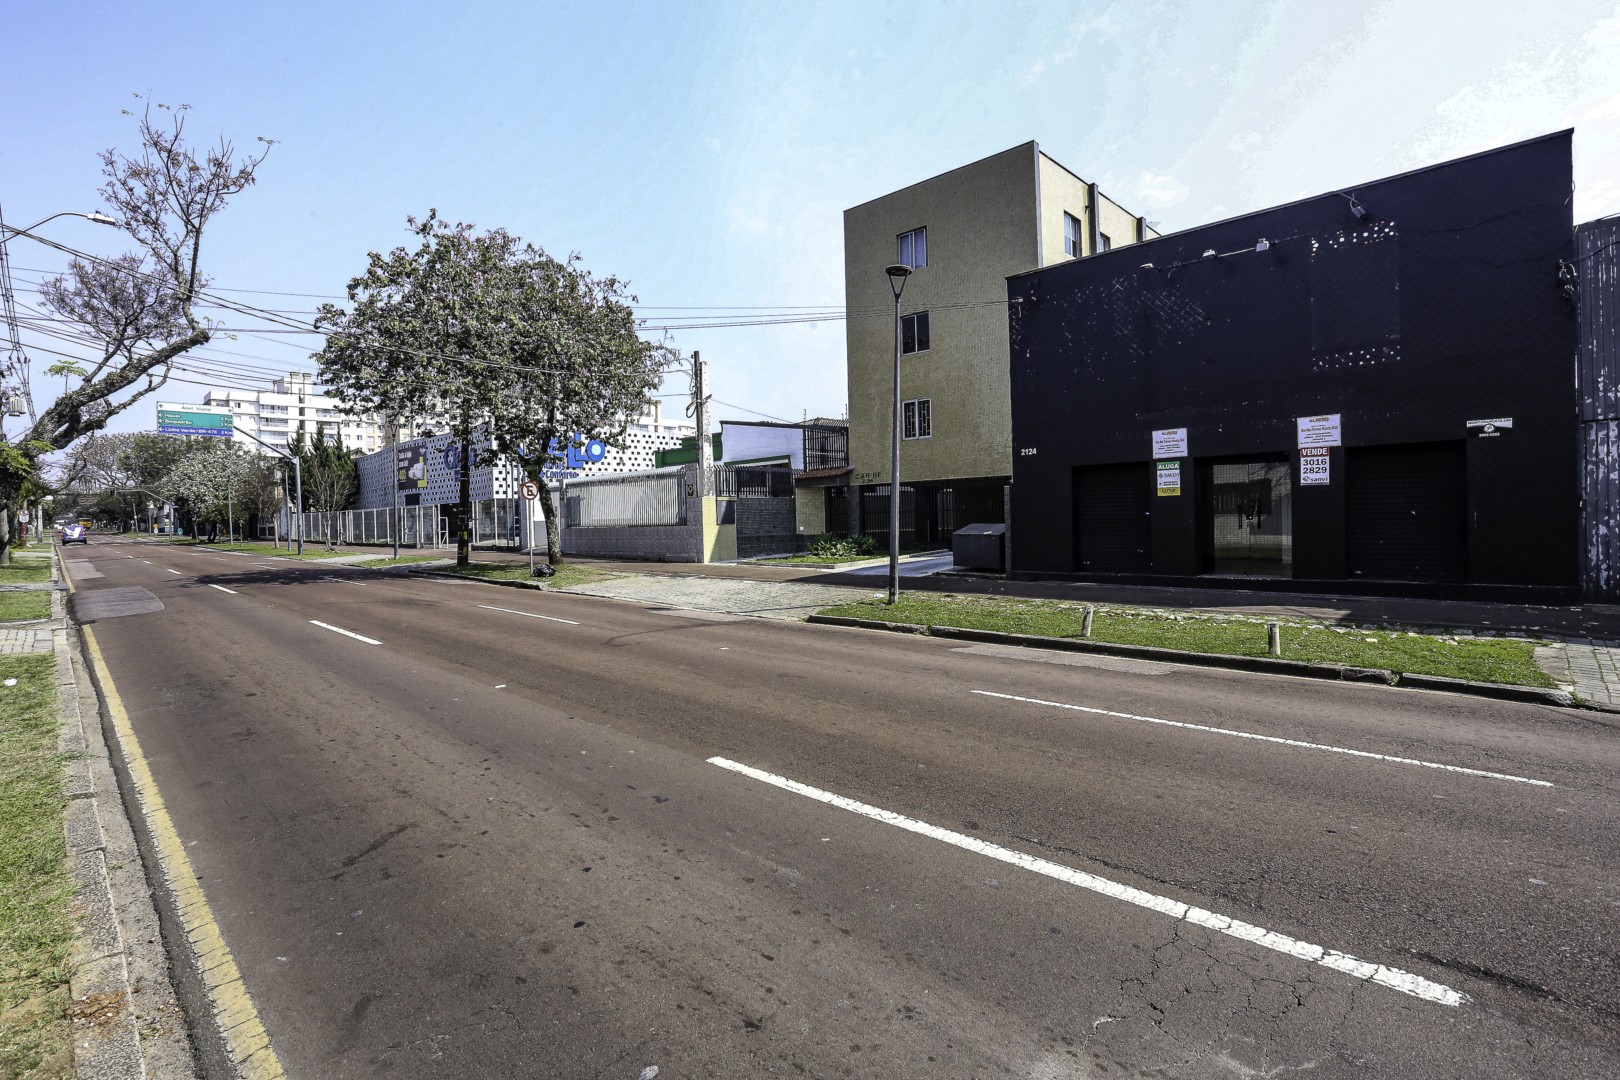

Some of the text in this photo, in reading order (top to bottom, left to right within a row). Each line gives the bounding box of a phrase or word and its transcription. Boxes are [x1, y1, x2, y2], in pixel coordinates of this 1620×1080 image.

[1302, 447, 1329, 456] VENDE
[1302, 458, 1327, 466] 3016
[1302, 466, 1327, 474] 2829
